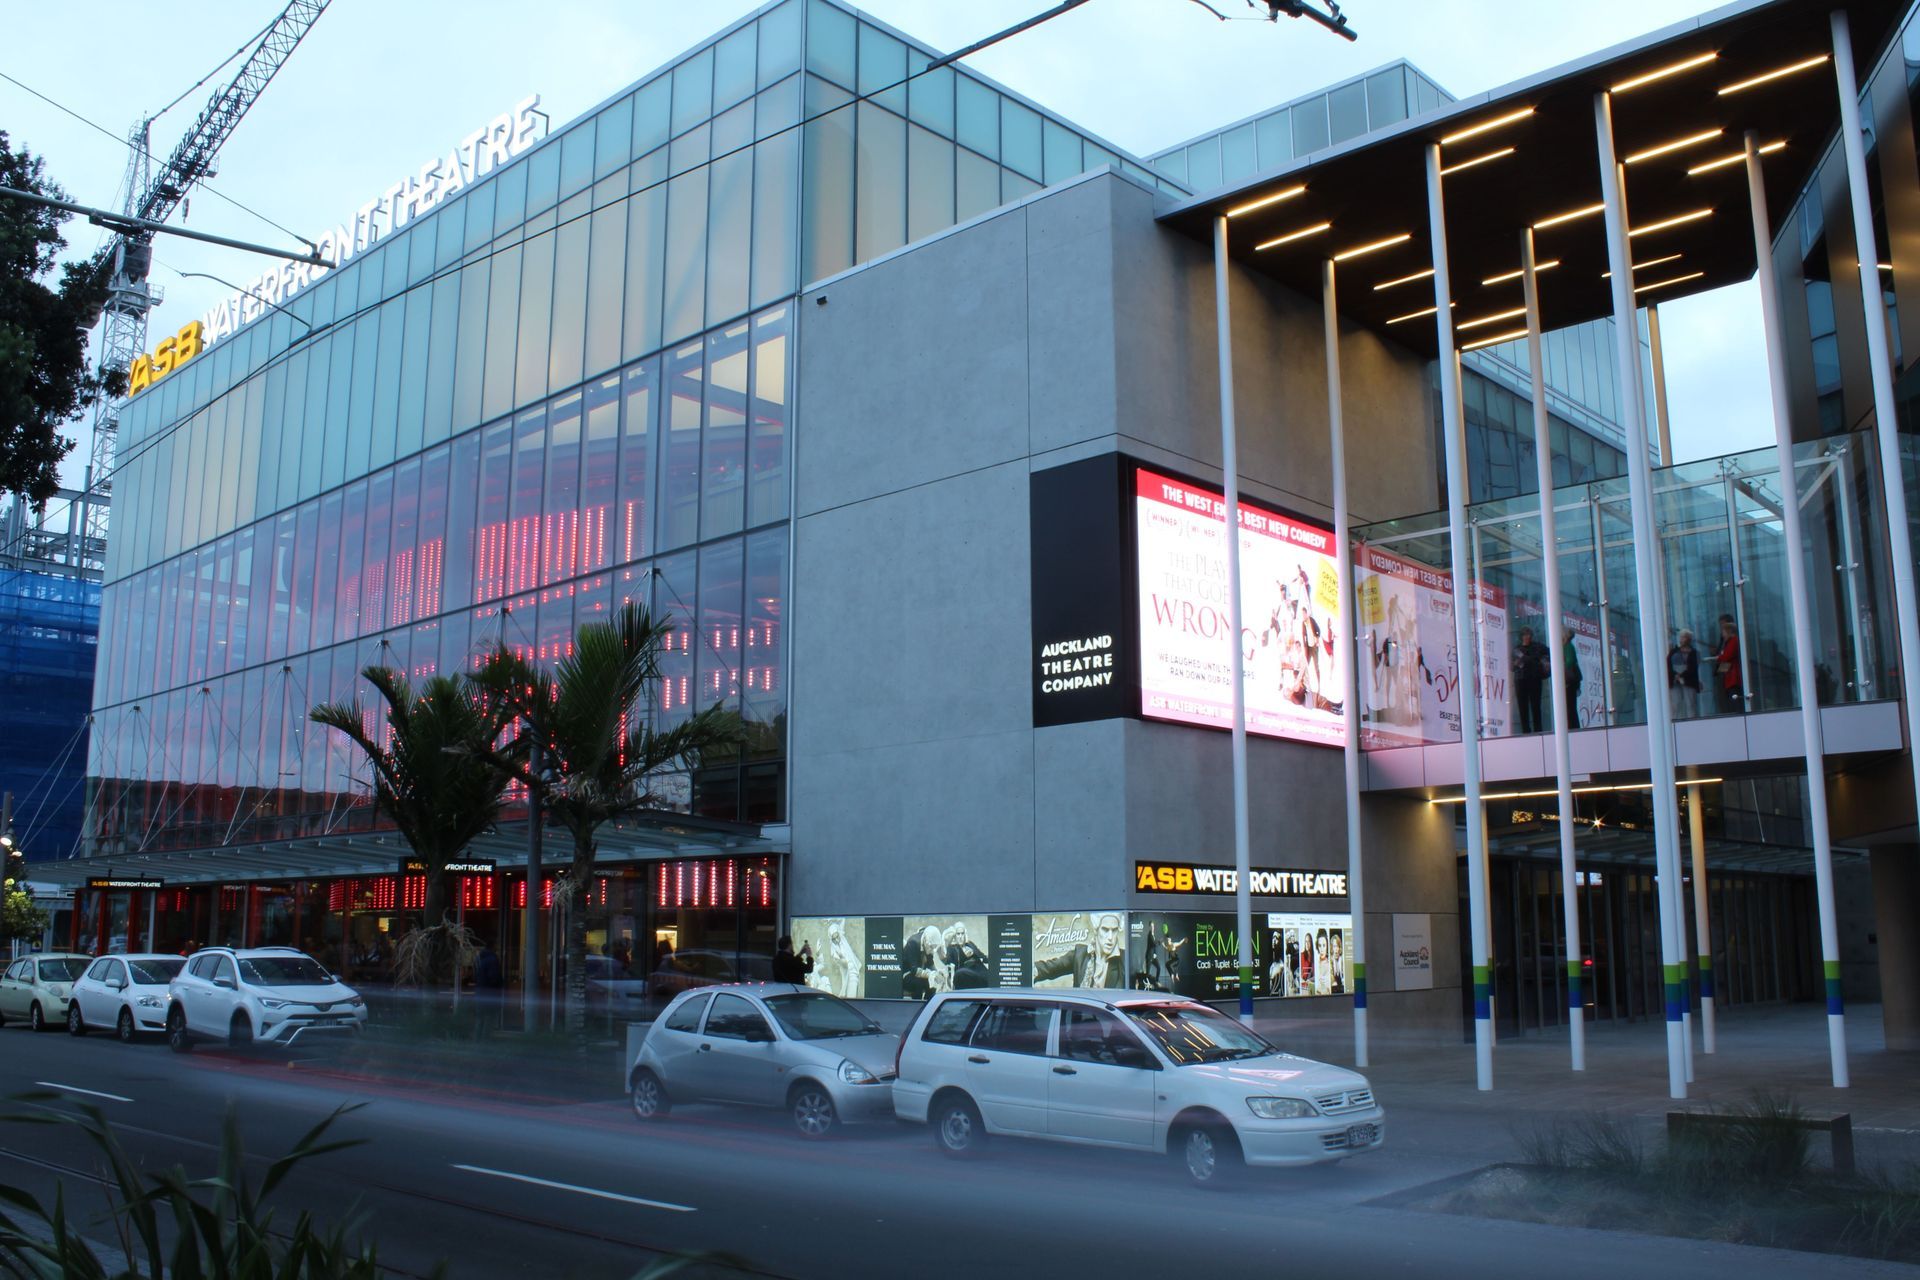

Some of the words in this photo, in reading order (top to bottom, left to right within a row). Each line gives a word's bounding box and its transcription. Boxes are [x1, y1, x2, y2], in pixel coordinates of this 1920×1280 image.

[129, 319, 204, 398] ASB
[202, 196, 382, 347] WATERFRONT
[384, 93, 542, 230] THEATRE
[1152, 512, 1178, 527] WINNER
[1162, 484, 1183, 504] THE
[1184, 491, 1212, 513] WEST
[1244, 513, 1268, 530] BEST
[1268, 521, 1289, 538] NEW
[1290, 526, 1327, 549] COMEDY
[1168, 551, 1191, 568] THE
[1163, 571, 1195, 591] THAT
[1198, 578, 1230, 604] GOE
[1041, 635, 1112, 658] AUCKLAND
[1041, 653, 1113, 675] THEATRE
[1171, 654, 1201, 669] LAUGHED
[1042, 672, 1113, 693] COMPANY
[1185, 670, 1206, 681] DOWN
[467, 864, 493, 872] THEATRE
[1137, 866, 1193, 891] ASB
[1193, 868, 1291, 894] WATERRONT
[1291, 873, 1347, 895] THEATRE
[1035, 913, 1089, 949] Amadeus
